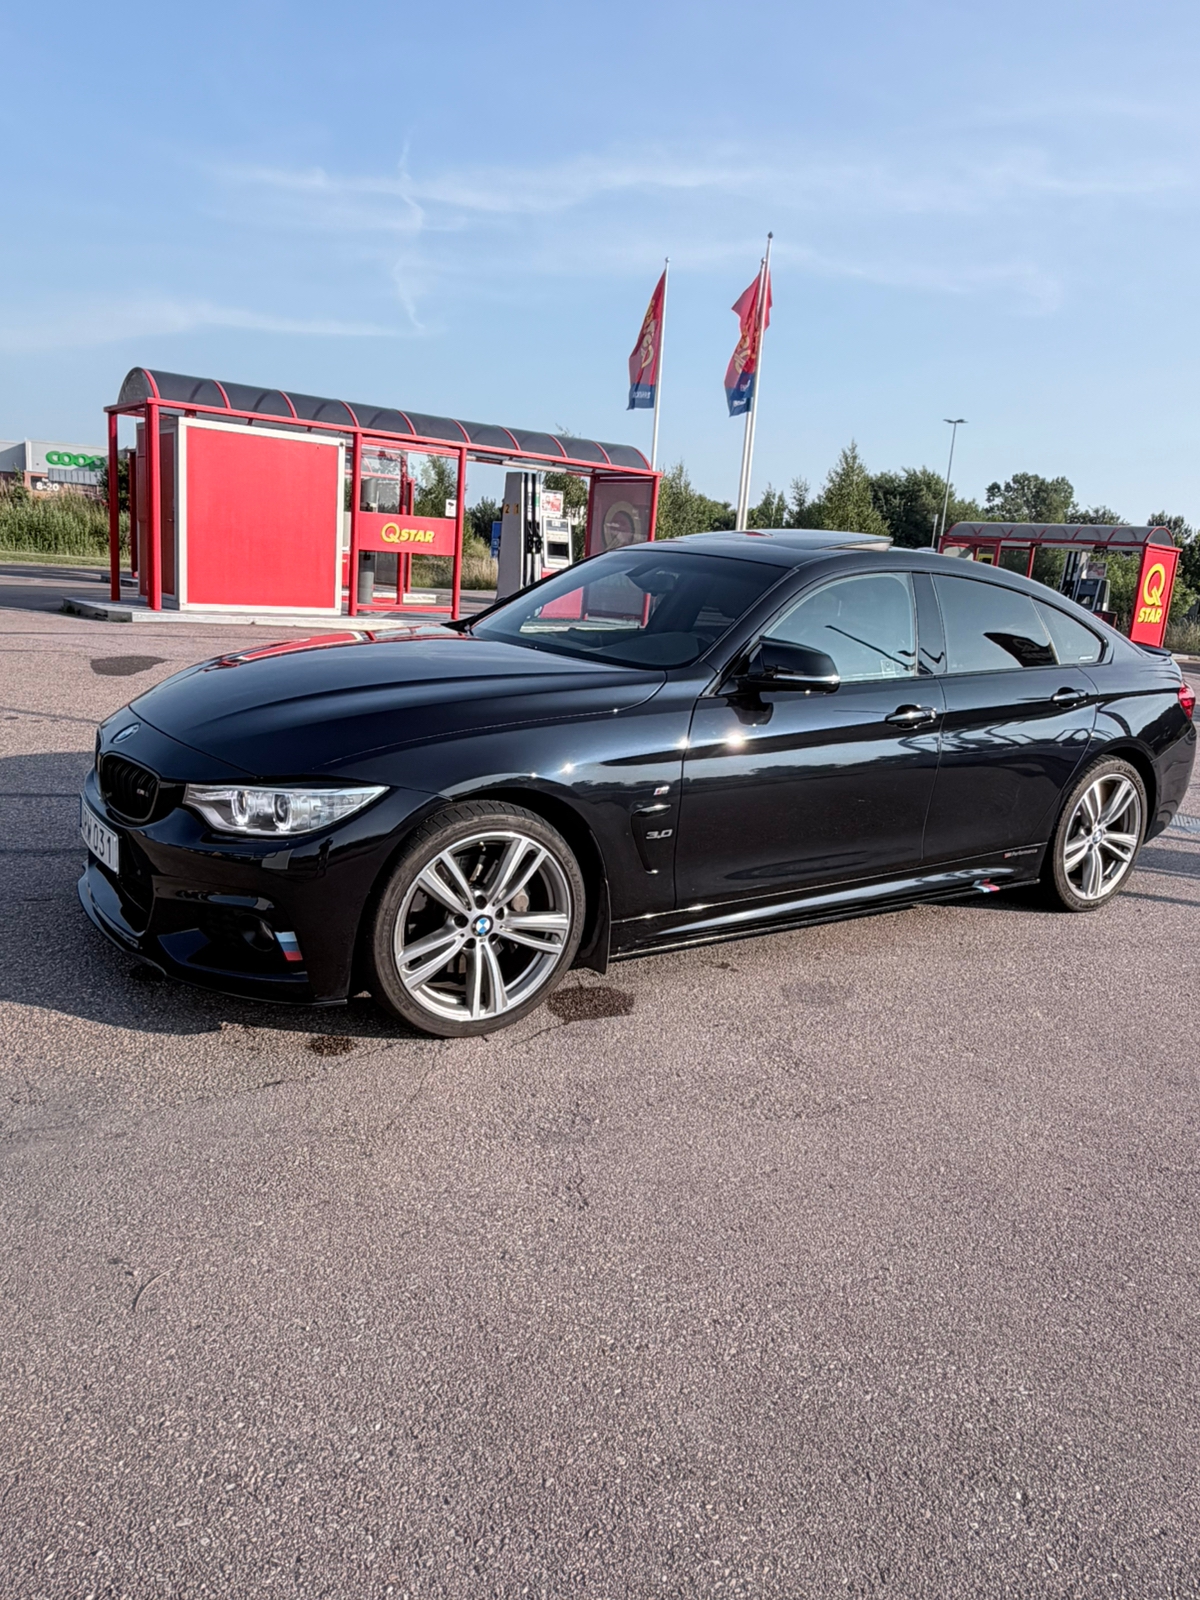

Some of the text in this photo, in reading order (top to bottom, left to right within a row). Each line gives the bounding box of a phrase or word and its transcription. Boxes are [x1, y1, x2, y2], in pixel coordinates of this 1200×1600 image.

[36, 481, 59, 491] 8-20
[1143, 563, 1166, 606] Q
[1137, 606, 1163, 623] STAR
[93, 823, 111, 864] 031
